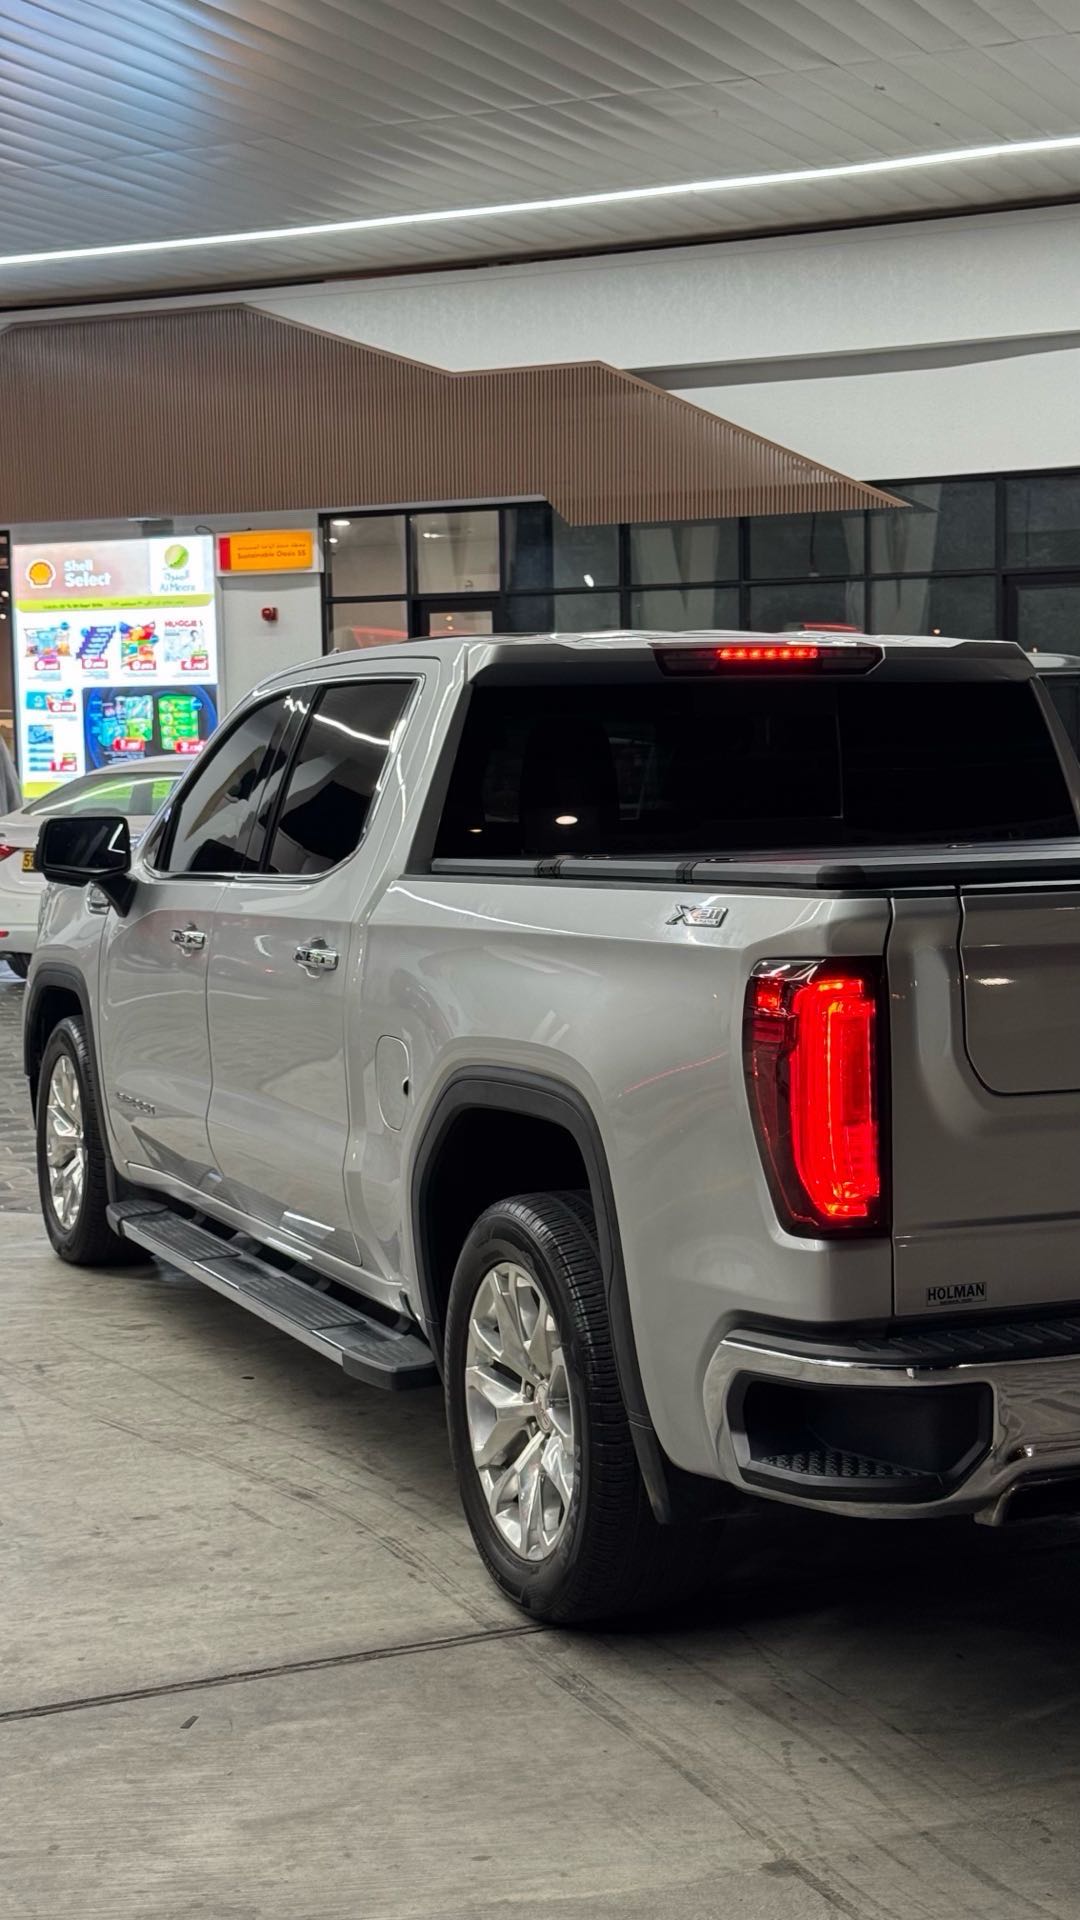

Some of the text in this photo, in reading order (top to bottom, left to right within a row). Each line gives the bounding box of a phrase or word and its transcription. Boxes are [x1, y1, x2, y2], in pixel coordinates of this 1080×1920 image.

[64, 559, 93, 571] Shell
[64, 570, 111, 587] Select
[928, 1283, 985, 1300] HOLMAN
